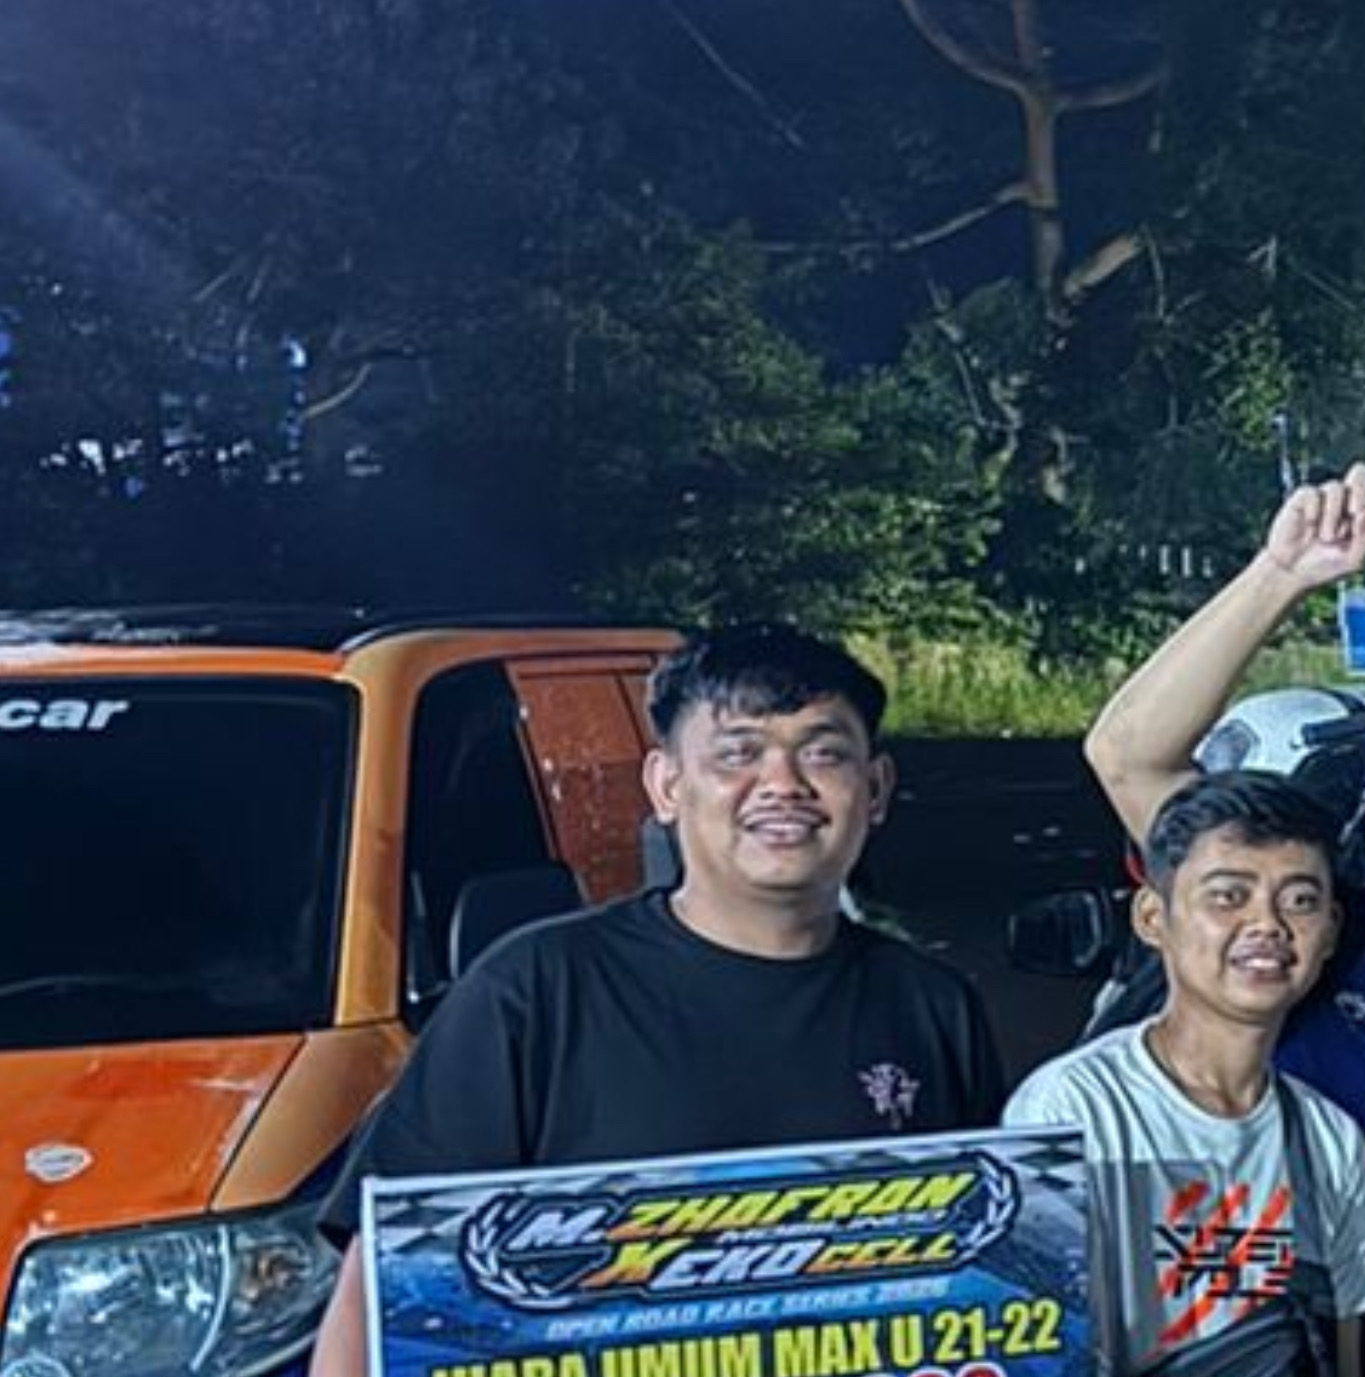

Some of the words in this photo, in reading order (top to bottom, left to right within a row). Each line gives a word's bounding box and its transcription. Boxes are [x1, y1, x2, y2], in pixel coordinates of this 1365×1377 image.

[0, 699, 129, 728] car
[545, 1313, 620, 1342] OPEN
[626, 1305, 696, 1333] ROAD
[703, 1295, 782, 1325] RACE
[889, 1313, 924, 1368] U
[932, 1298, 1062, 1363] 21-22
